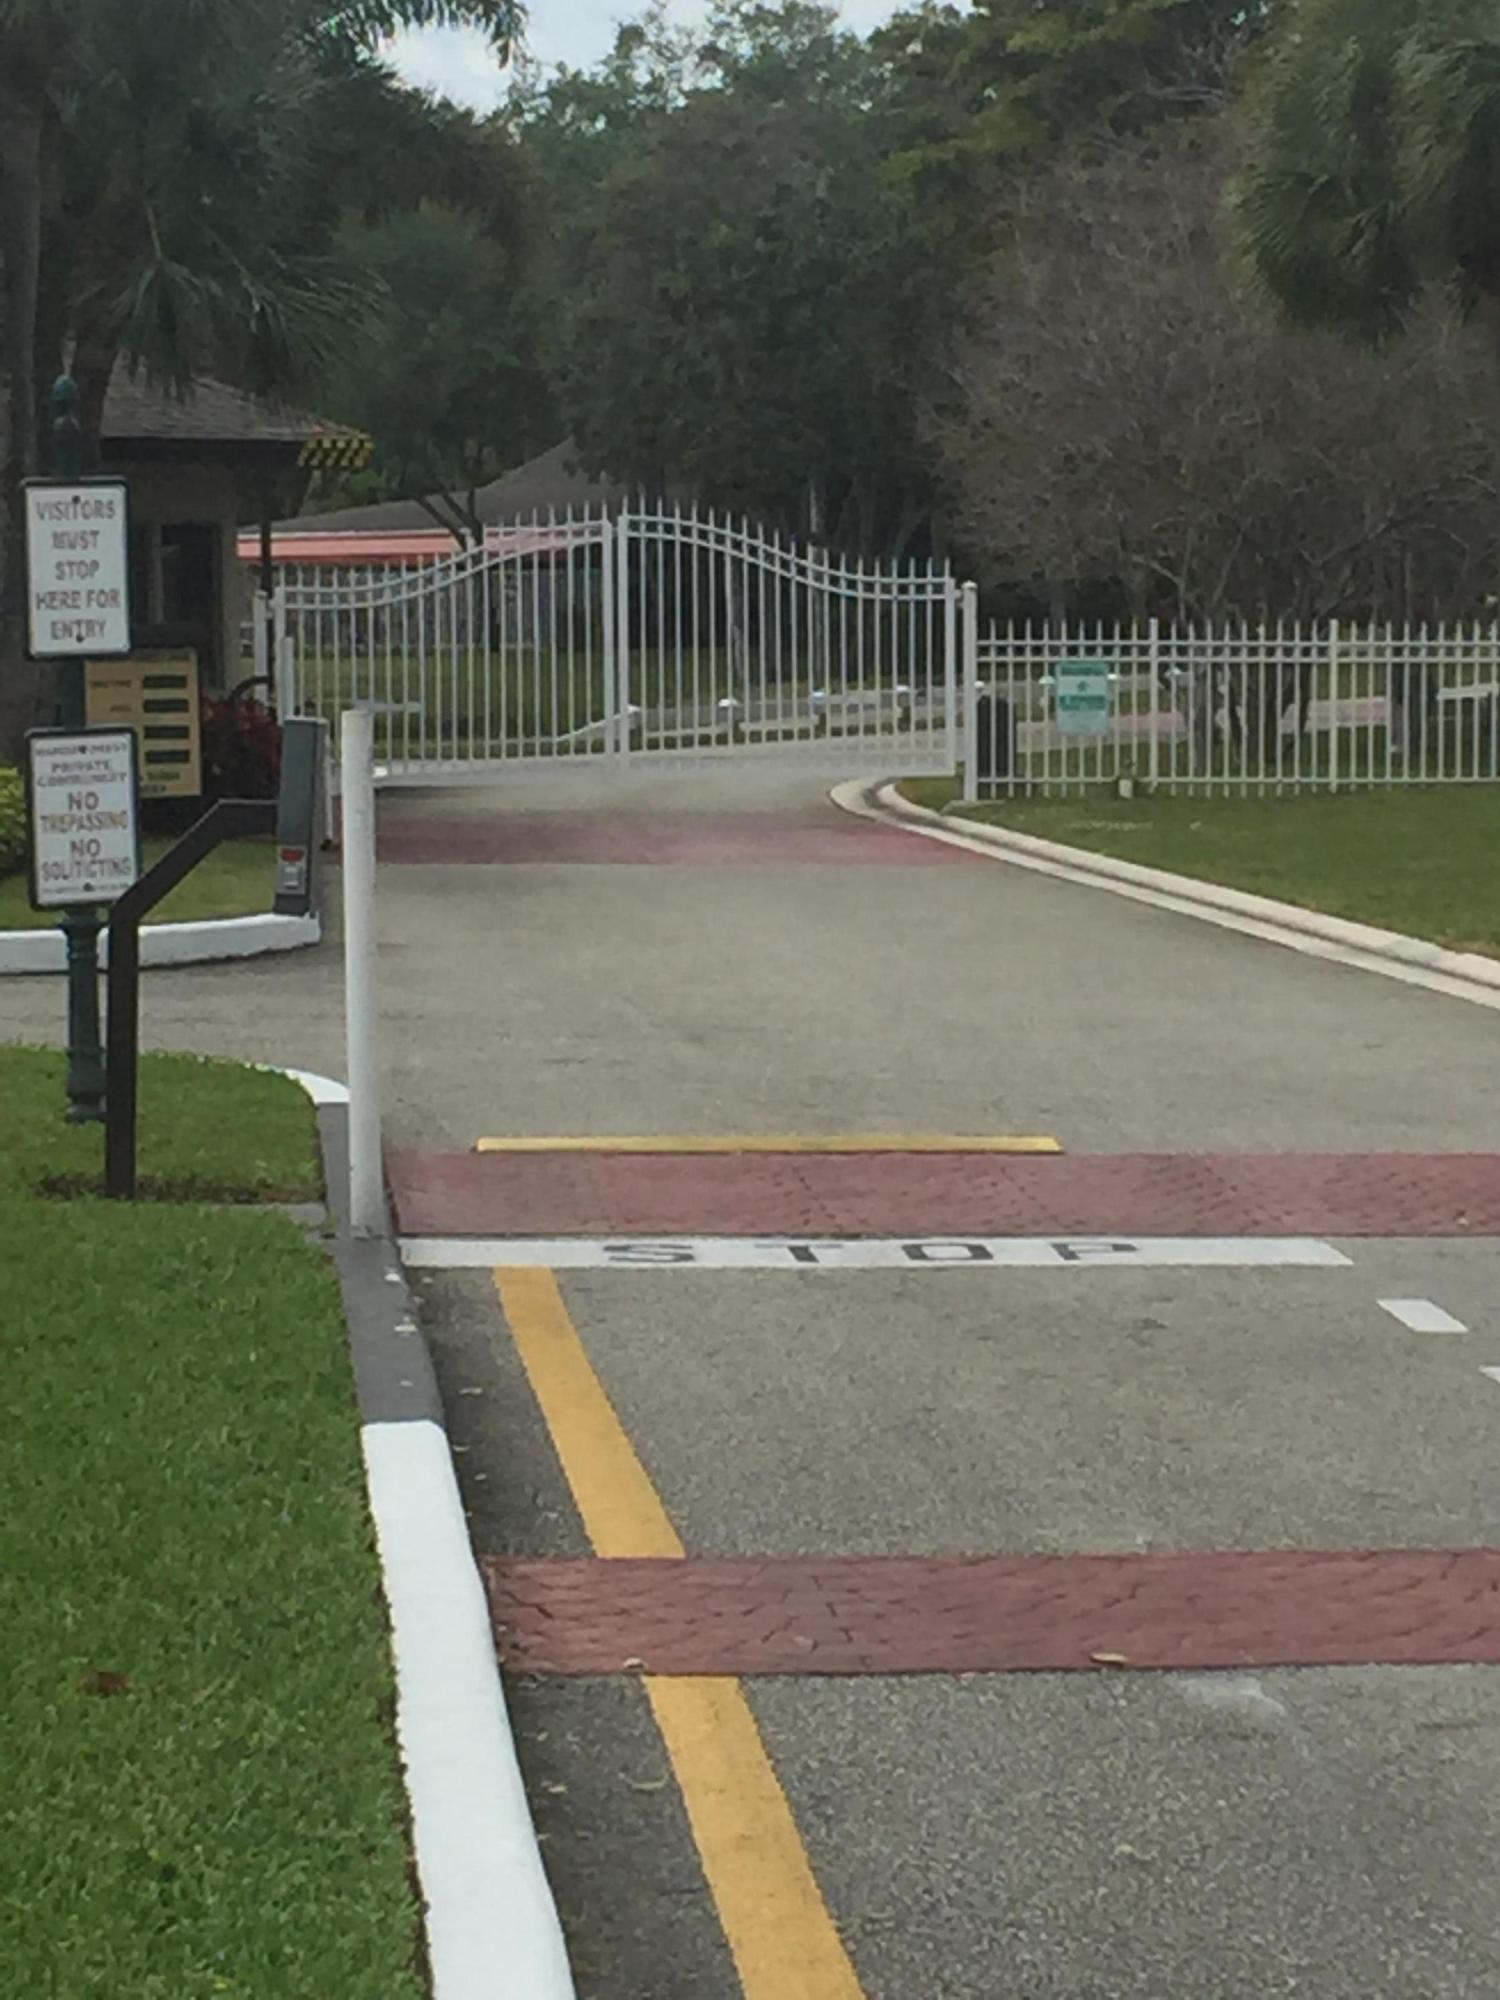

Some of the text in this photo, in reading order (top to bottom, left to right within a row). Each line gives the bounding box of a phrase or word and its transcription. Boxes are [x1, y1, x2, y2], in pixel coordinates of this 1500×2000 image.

[36, 500, 116, 521] VISITORS
[52, 530, 100, 550] MUST
[55, 559, 100, 580] STOP
[36, 588, 120, 610] HERE FOR
[50, 618, 107, 640] ENTRY
[67, 791, 99, 811] NO
[70, 838, 101, 858] NO
[603, 1242, 1139, 1264] STOP
